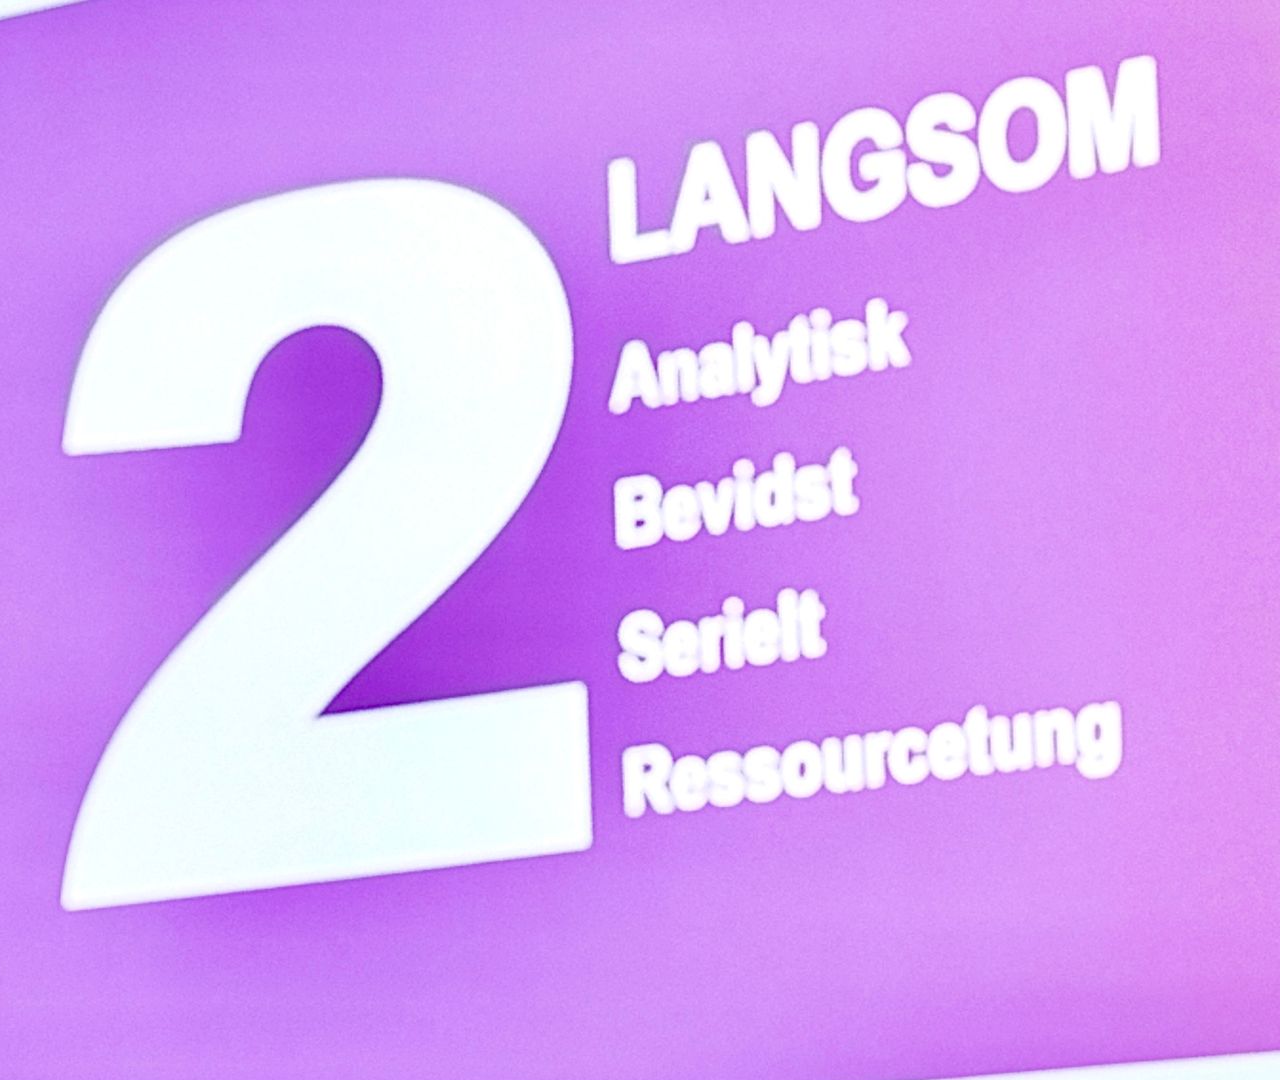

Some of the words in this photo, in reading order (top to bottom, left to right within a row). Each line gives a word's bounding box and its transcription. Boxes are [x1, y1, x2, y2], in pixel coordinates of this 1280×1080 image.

[607, 53, 1161, 265] LANGSOM
[608, 297, 912, 414] Analytisk
[60, 176, 594, 912] 2
[613, 446, 860, 550] Bevidst
[617, 587, 828, 683] Serielt
[621, 700, 1124, 818] Ressourcetung
